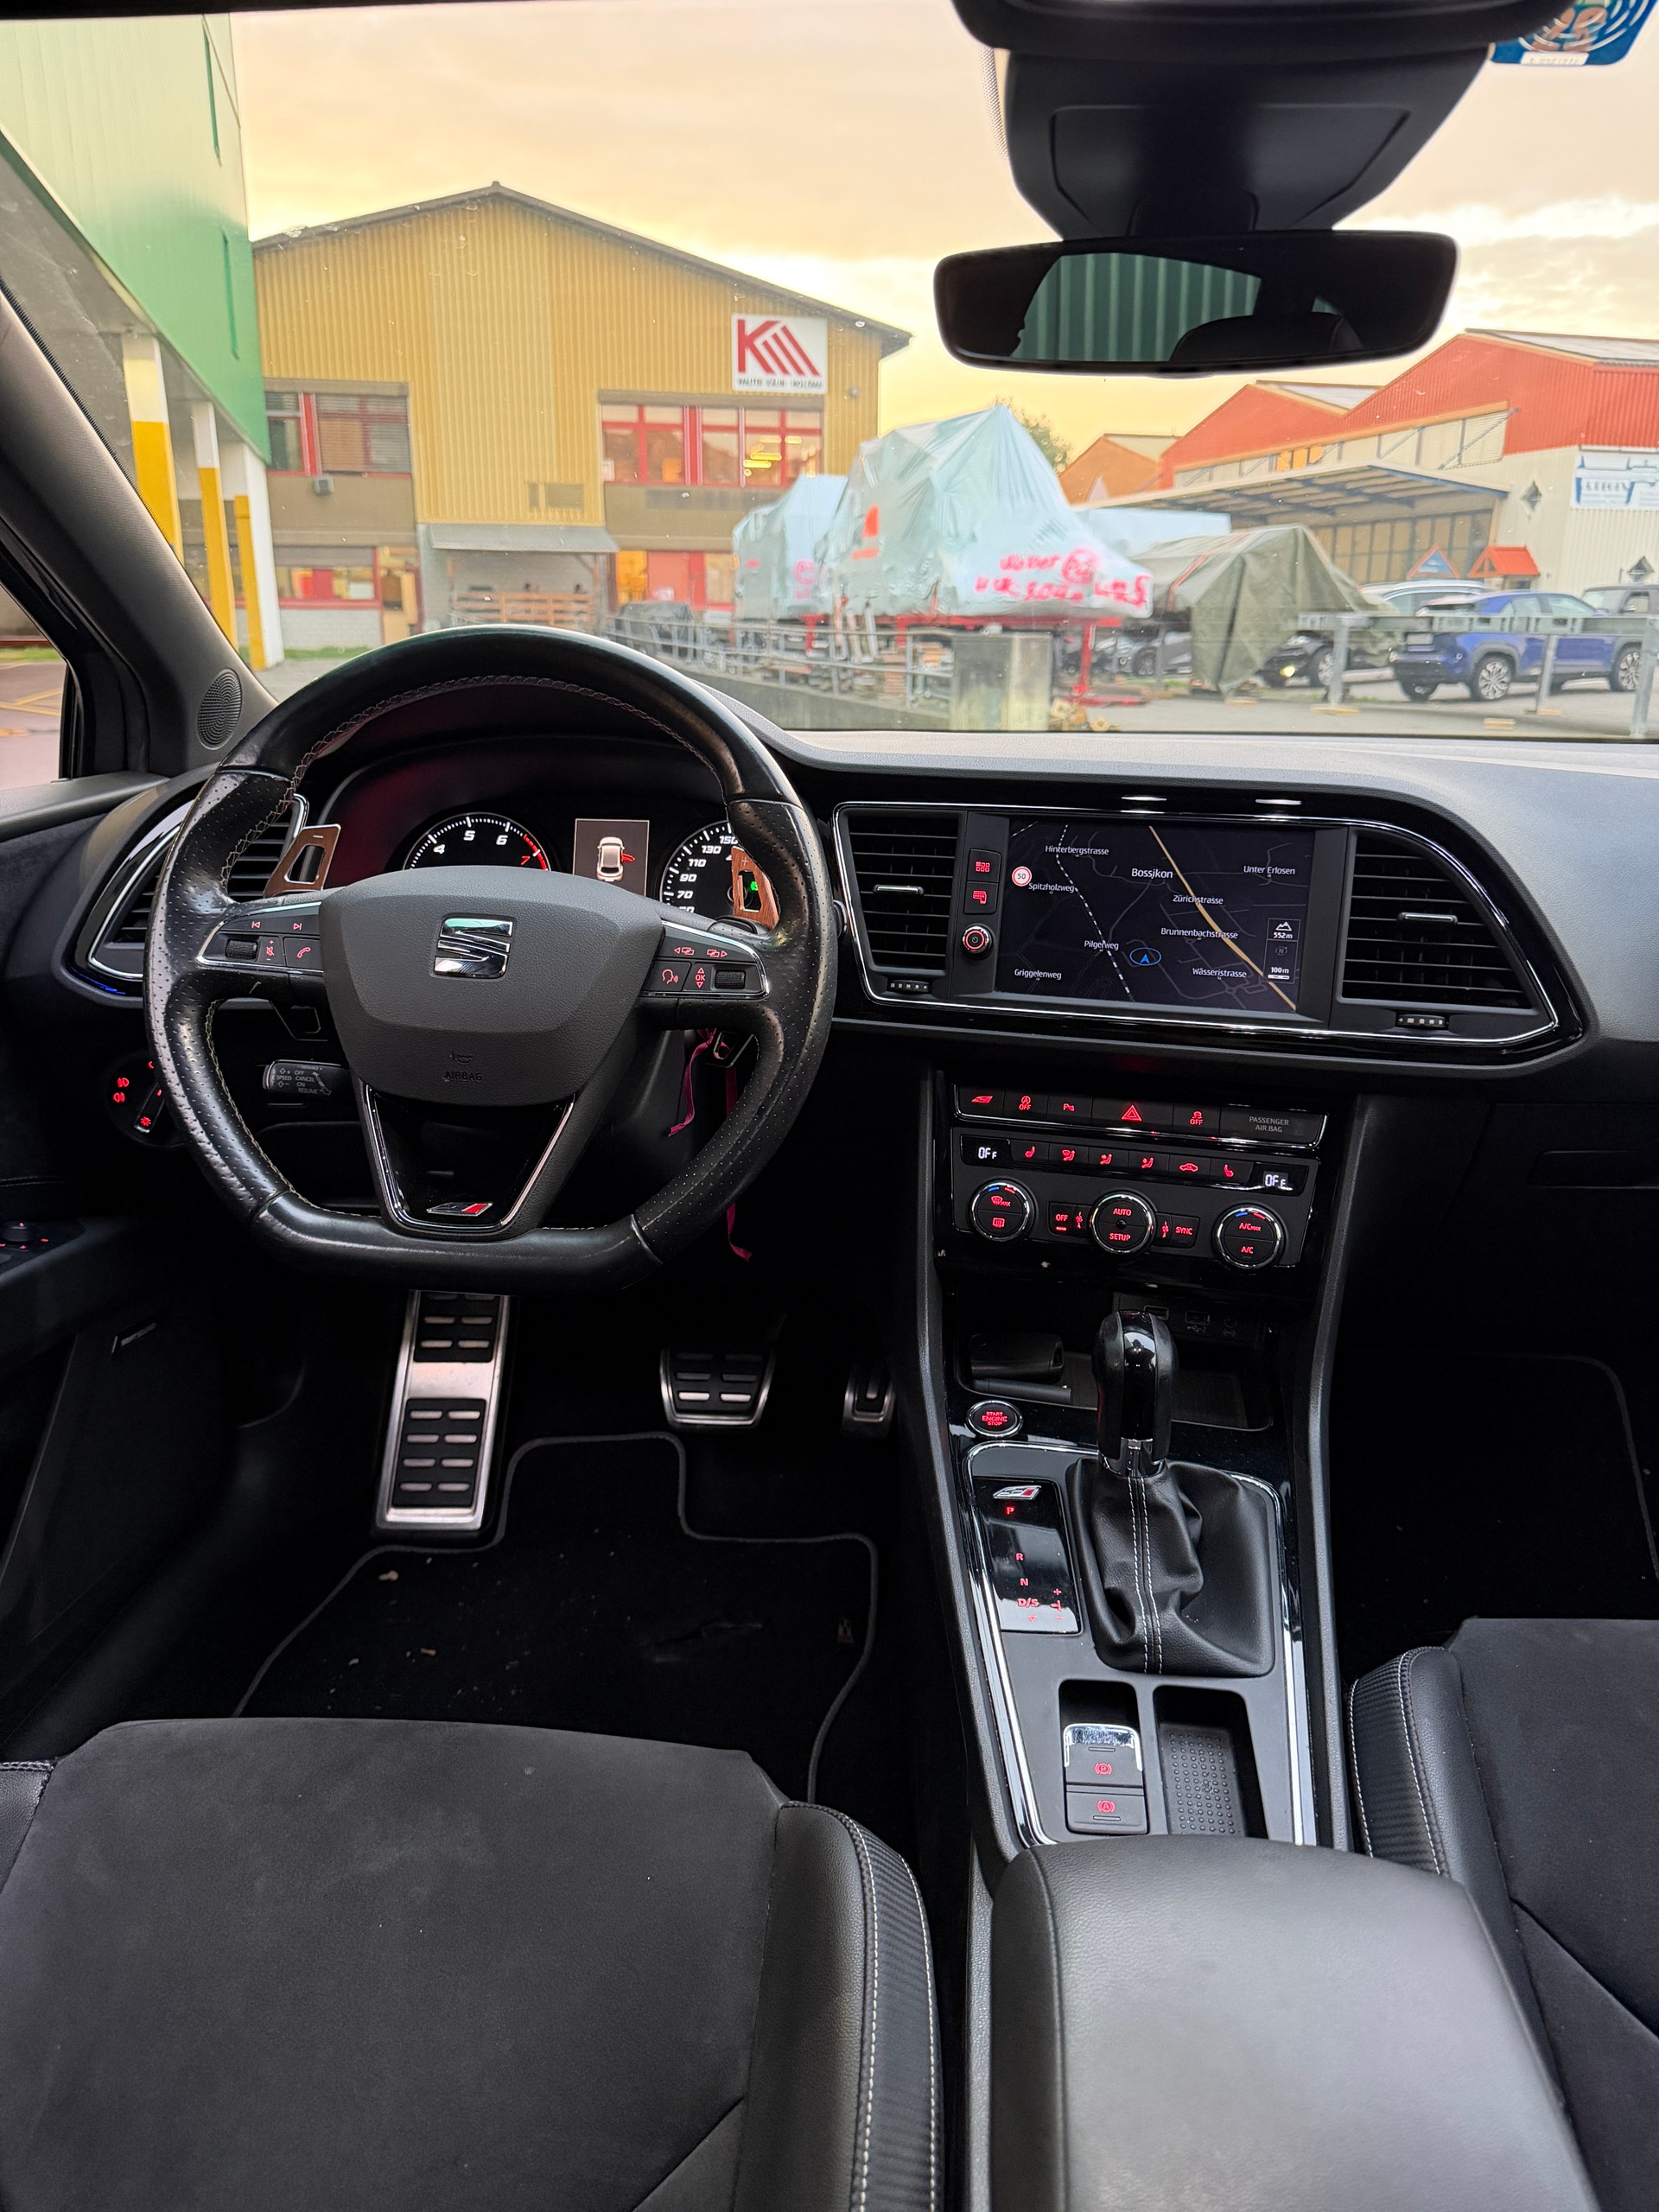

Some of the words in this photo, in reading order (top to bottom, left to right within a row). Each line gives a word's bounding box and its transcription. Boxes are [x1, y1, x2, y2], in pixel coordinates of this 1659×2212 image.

[463, 830, 475, 841] 5
[496, 835, 508, 845] 6
[433, 844, 446, 855] 4
[701, 845, 721, 854] 130
[1045, 845, 1109, 856] Hinterbergstrasse
[520, 855, 531, 866] 7
[688, 858, 707, 868] 110
[1131, 868, 1173, 879] Bossikon
[1243, 865, 1265, 874] Unter
[1268, 867, 1296, 875] Erlosen
[679, 874, 697, 882] 90
[1027, 881, 1075, 893] Spitzholzweg
[677, 890, 694, 899] 70
[1173, 894, 1224, 905] Zürichstrasse
[1160, 927, 1238, 939] Brunnenbachstrasse
[1084, 939, 1119, 950] Pilgerweg
[1014, 969, 1062, 981] Griggelenweg
[444, 1071, 483, 1082] AIRBAG
[1249, 1116, 1289, 1126] PASSENGER
[978, 1147, 997, 1160] OFF
[1264, 1173, 1287, 1187] OFF
[1056, 1213, 1068, 1222] OFF
[1113, 1208, 1132, 1217] AUTO
[1175, 1226, 1193, 1236] SYNC
[1109, 1232, 1131, 1242] SETUP
[1241, 1246, 1254, 1255] A/C
[1015, 1553, 1024, 1561] R
[1020, 1578, 1029, 1586] N
[1017, 1598, 1039, 1608] D/S
